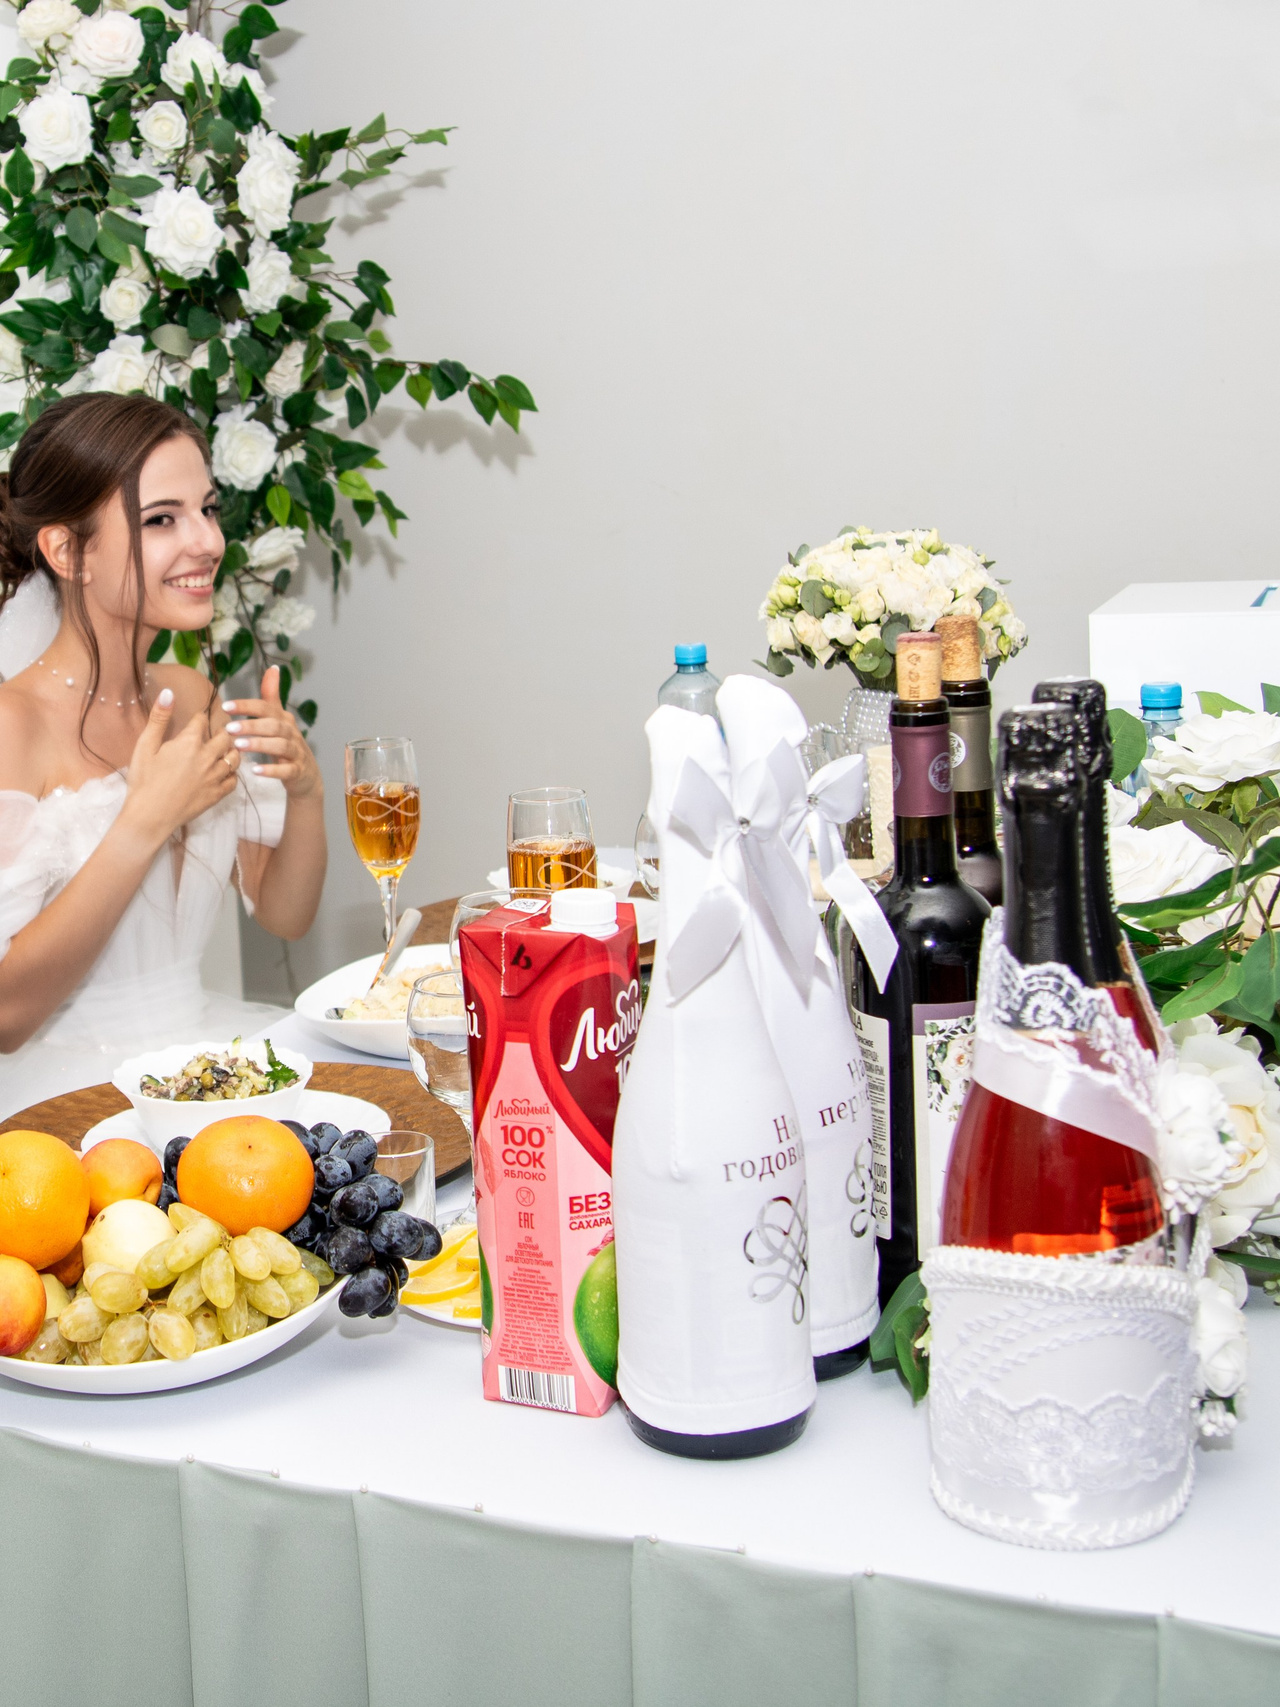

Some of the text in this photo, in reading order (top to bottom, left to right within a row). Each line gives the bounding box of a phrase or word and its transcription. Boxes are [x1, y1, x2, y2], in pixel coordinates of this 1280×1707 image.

[493, 1098, 551, 1119] Любимый
[502, 1148, 546, 1170] СОК
[503, 1169, 547, 1182] ЯБЛОКО
[568, 1191, 612, 1215] БЕЗ
[568, 1216, 613, 1231] САХАРА
